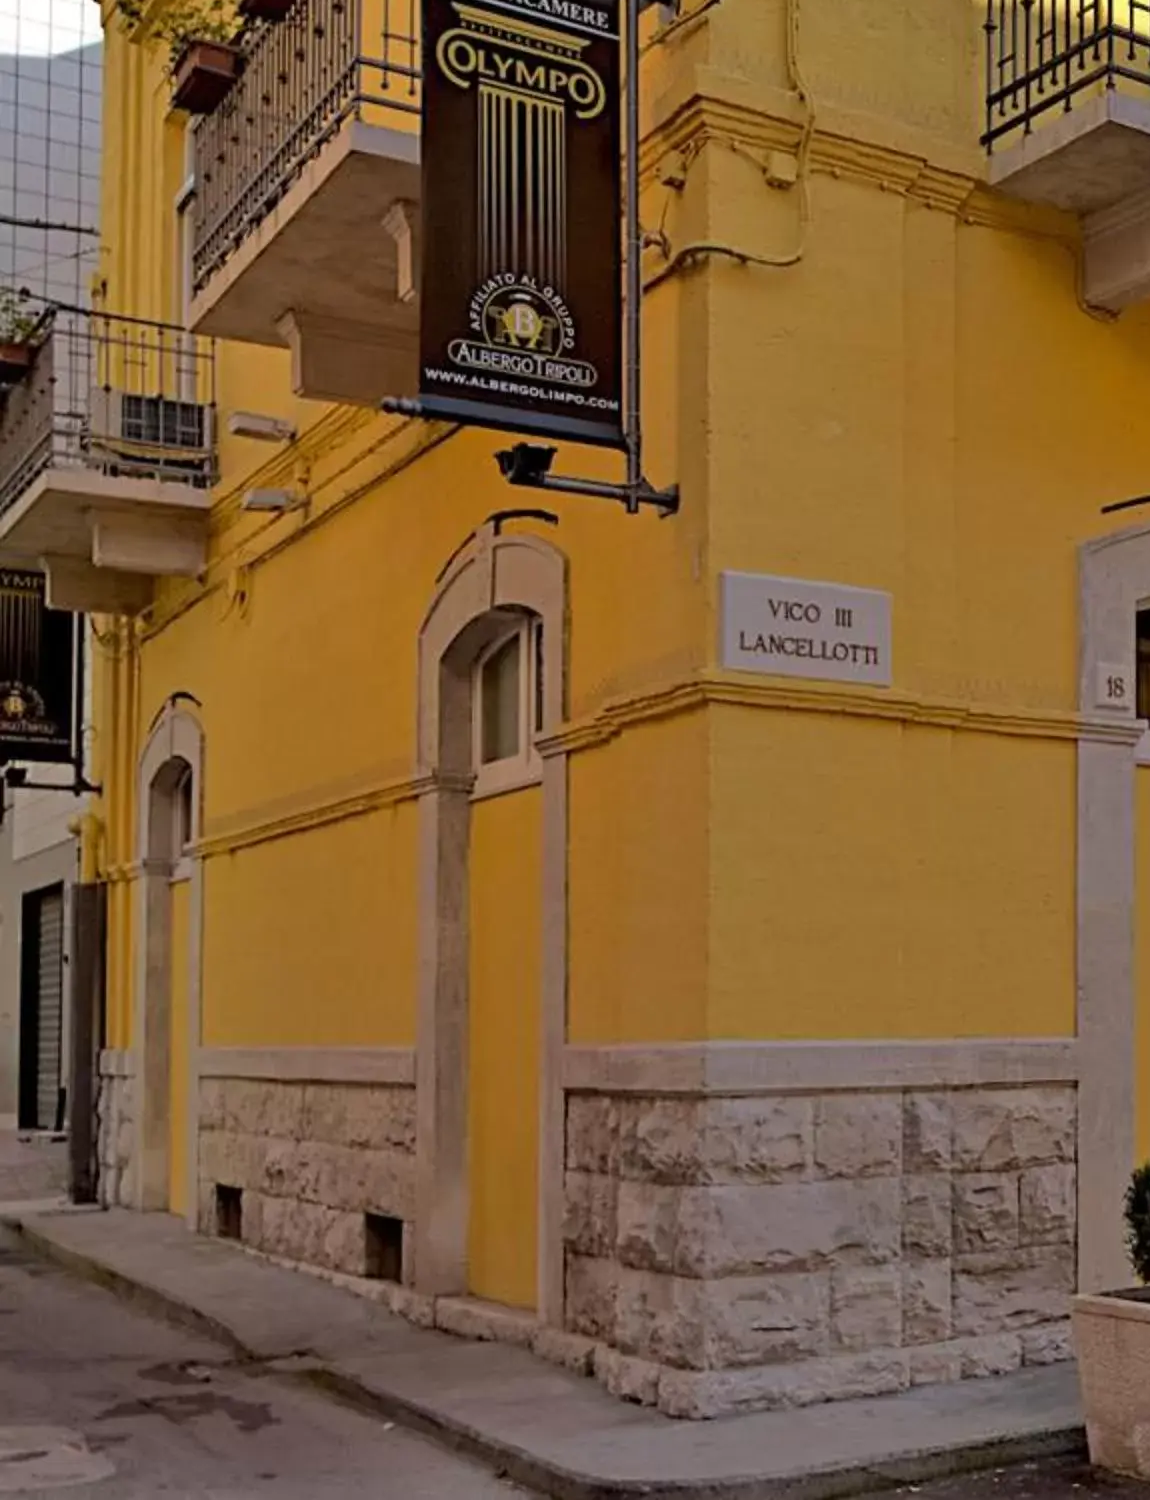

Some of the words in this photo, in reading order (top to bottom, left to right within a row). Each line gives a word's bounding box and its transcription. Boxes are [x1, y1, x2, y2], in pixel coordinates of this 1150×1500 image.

[447, 39, 595, 104] OLYMPO
[469, 273, 515, 331] AFFILIATO
[521, 275, 538, 289] AL
[543, 287, 575, 349] GRUPPO
[768, 599, 821, 623] VICO
[835, 608, 853, 628] III
[739, 631, 879, 665] LANCELLOTTI
[1107, 675, 1125, 698] 18
